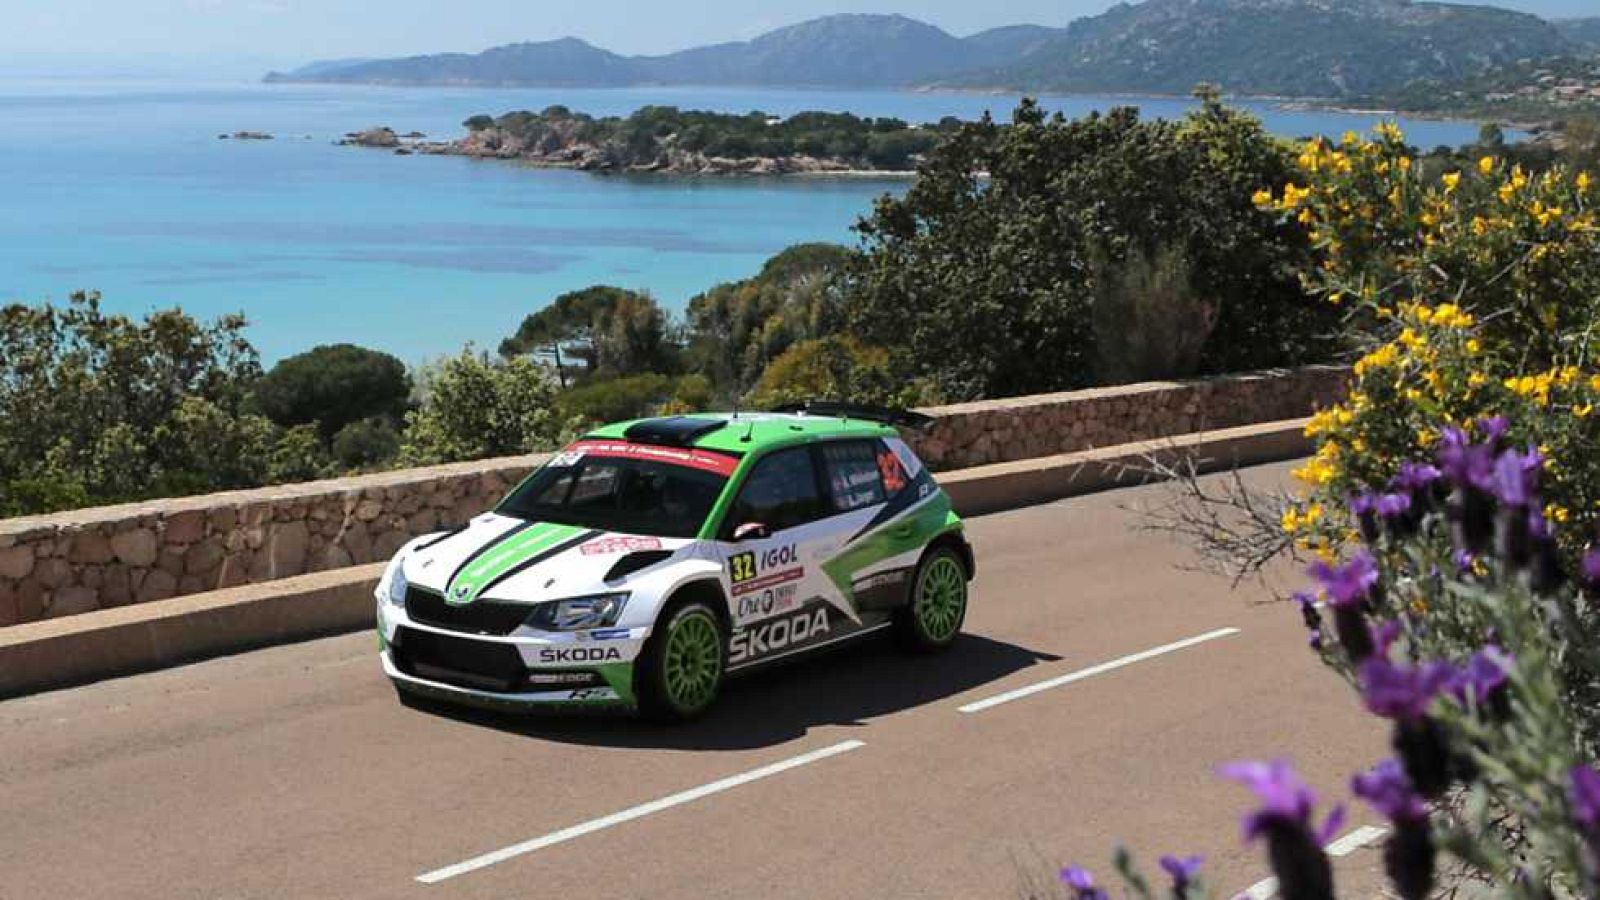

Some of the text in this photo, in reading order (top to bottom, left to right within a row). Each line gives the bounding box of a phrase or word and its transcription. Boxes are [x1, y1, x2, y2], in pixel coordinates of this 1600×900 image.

[733, 553, 753, 581] 32
[760, 543, 798, 570] IGOL
[729, 607, 831, 663] ŠKODA
